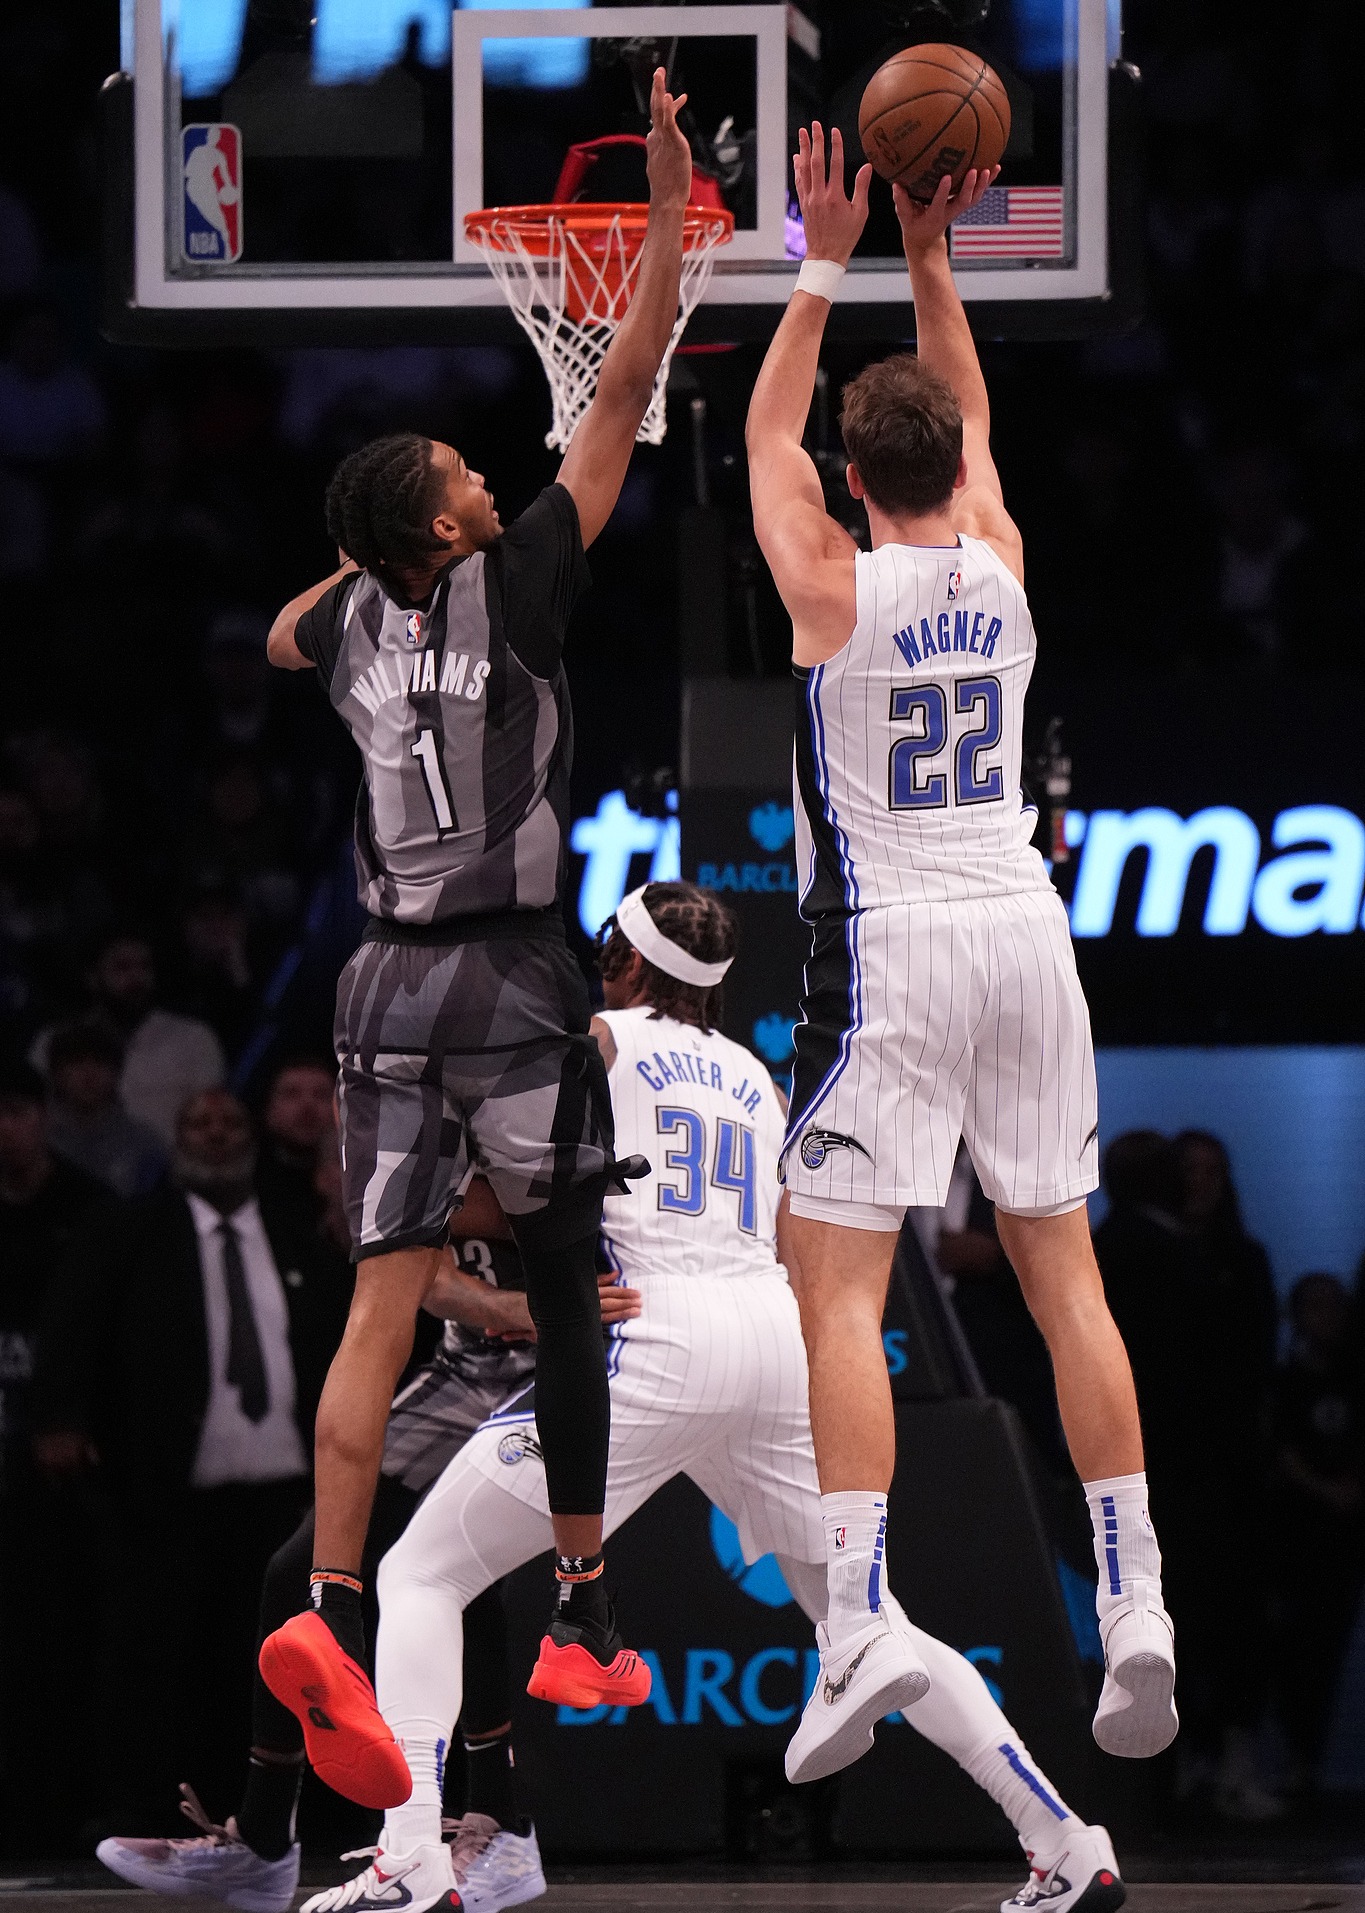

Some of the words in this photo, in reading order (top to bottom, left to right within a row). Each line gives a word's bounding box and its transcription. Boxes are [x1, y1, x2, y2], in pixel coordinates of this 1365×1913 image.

[189, 232, 220, 254] NBA
[892, 610, 1003, 669] WAGNER
[350, 649, 491, 717] WILLIAMS
[888, 675, 1004, 811] 22
[410, 728, 456, 831] 1
[636, 1051, 723, 1092] CARTER
[655, 1105, 757, 1236] 34
[449, 1240, 498, 1289] 3
